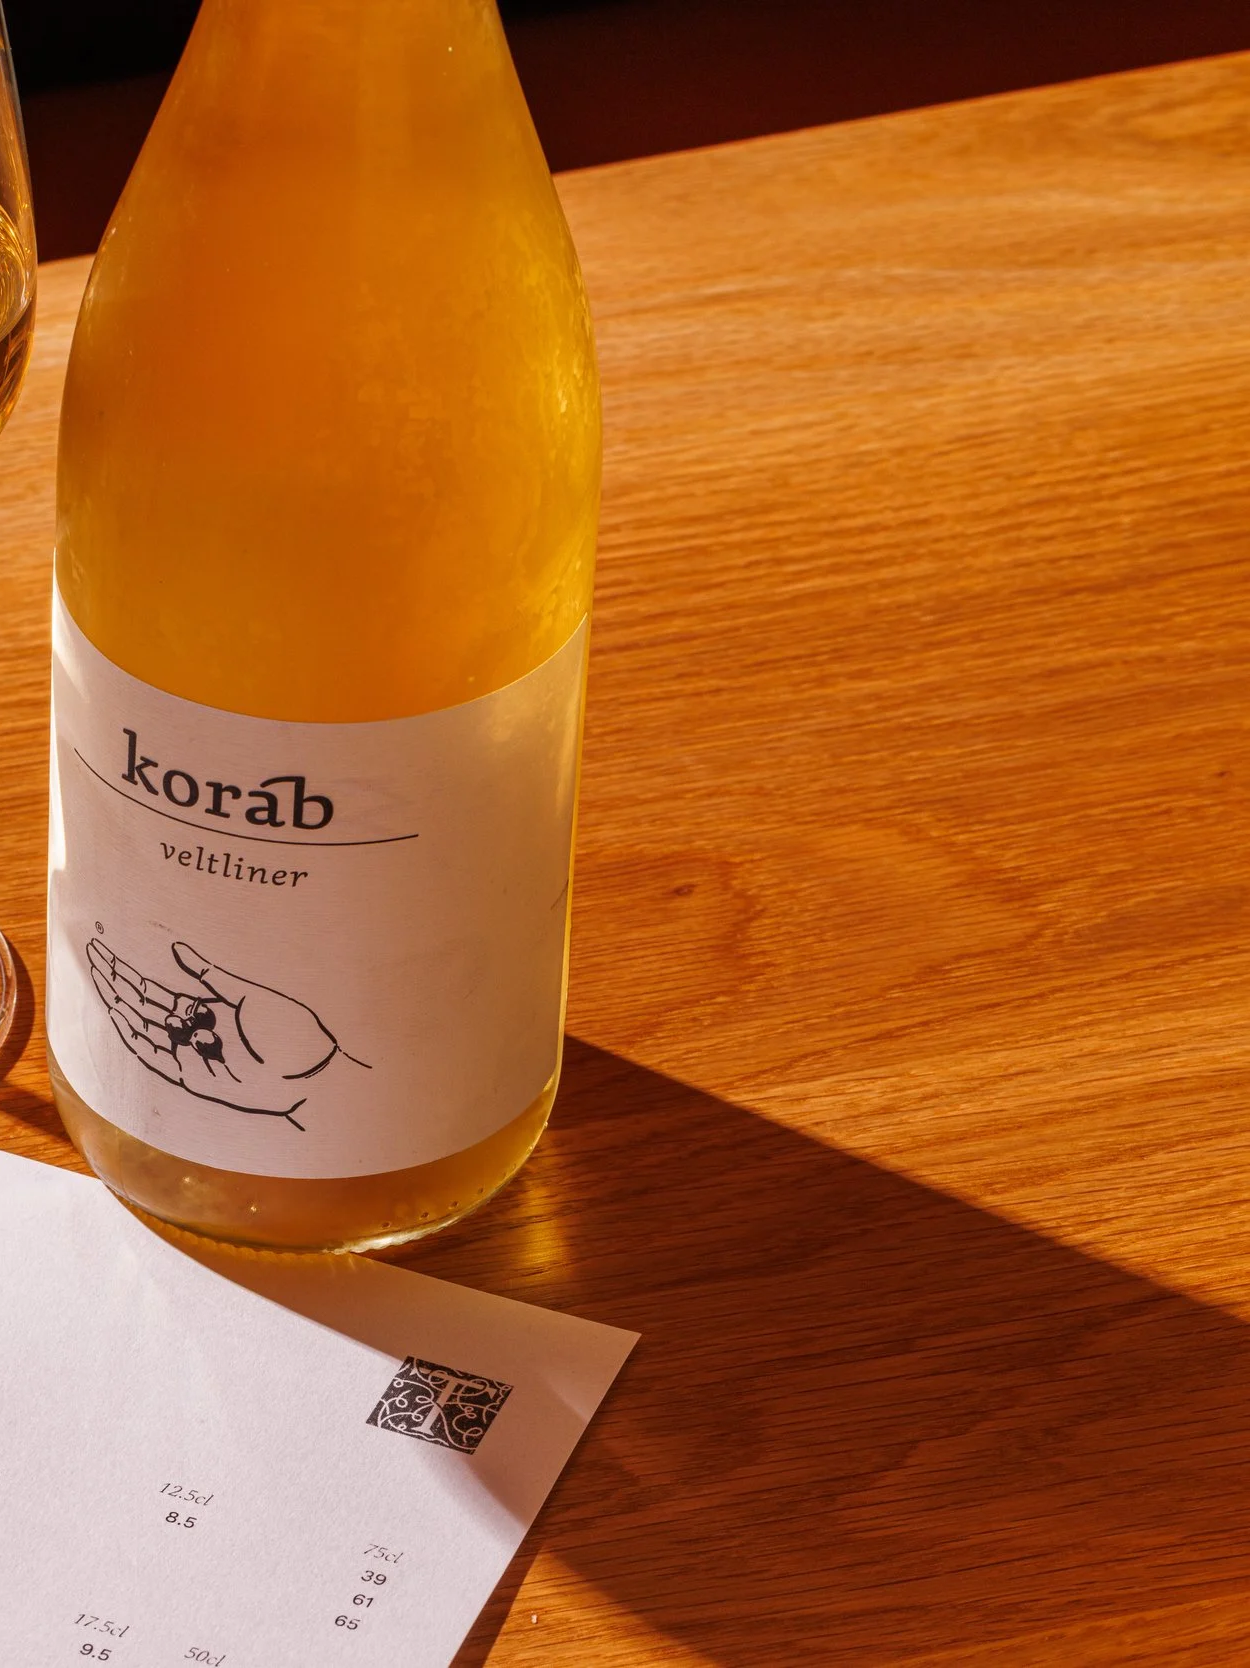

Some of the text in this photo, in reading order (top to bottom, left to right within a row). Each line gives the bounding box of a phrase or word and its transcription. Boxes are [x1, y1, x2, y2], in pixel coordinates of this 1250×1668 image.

[160, 842, 308, 887] veltliner
[158, 1482, 215, 1507] 12.5cl
[164, 1510, 198, 1529] 8.5
[362, 1543, 405, 1564] 75cl
[360, 1569, 388, 1586] 39
[351, 1593, 375, 1609] 61
[73, 1613, 131, 1639] 17.5cl
[333, 1614, 362, 1631] 65
[78, 1642, 113, 1662] 9.5
[184, 1646, 226, 1667] 50cl
